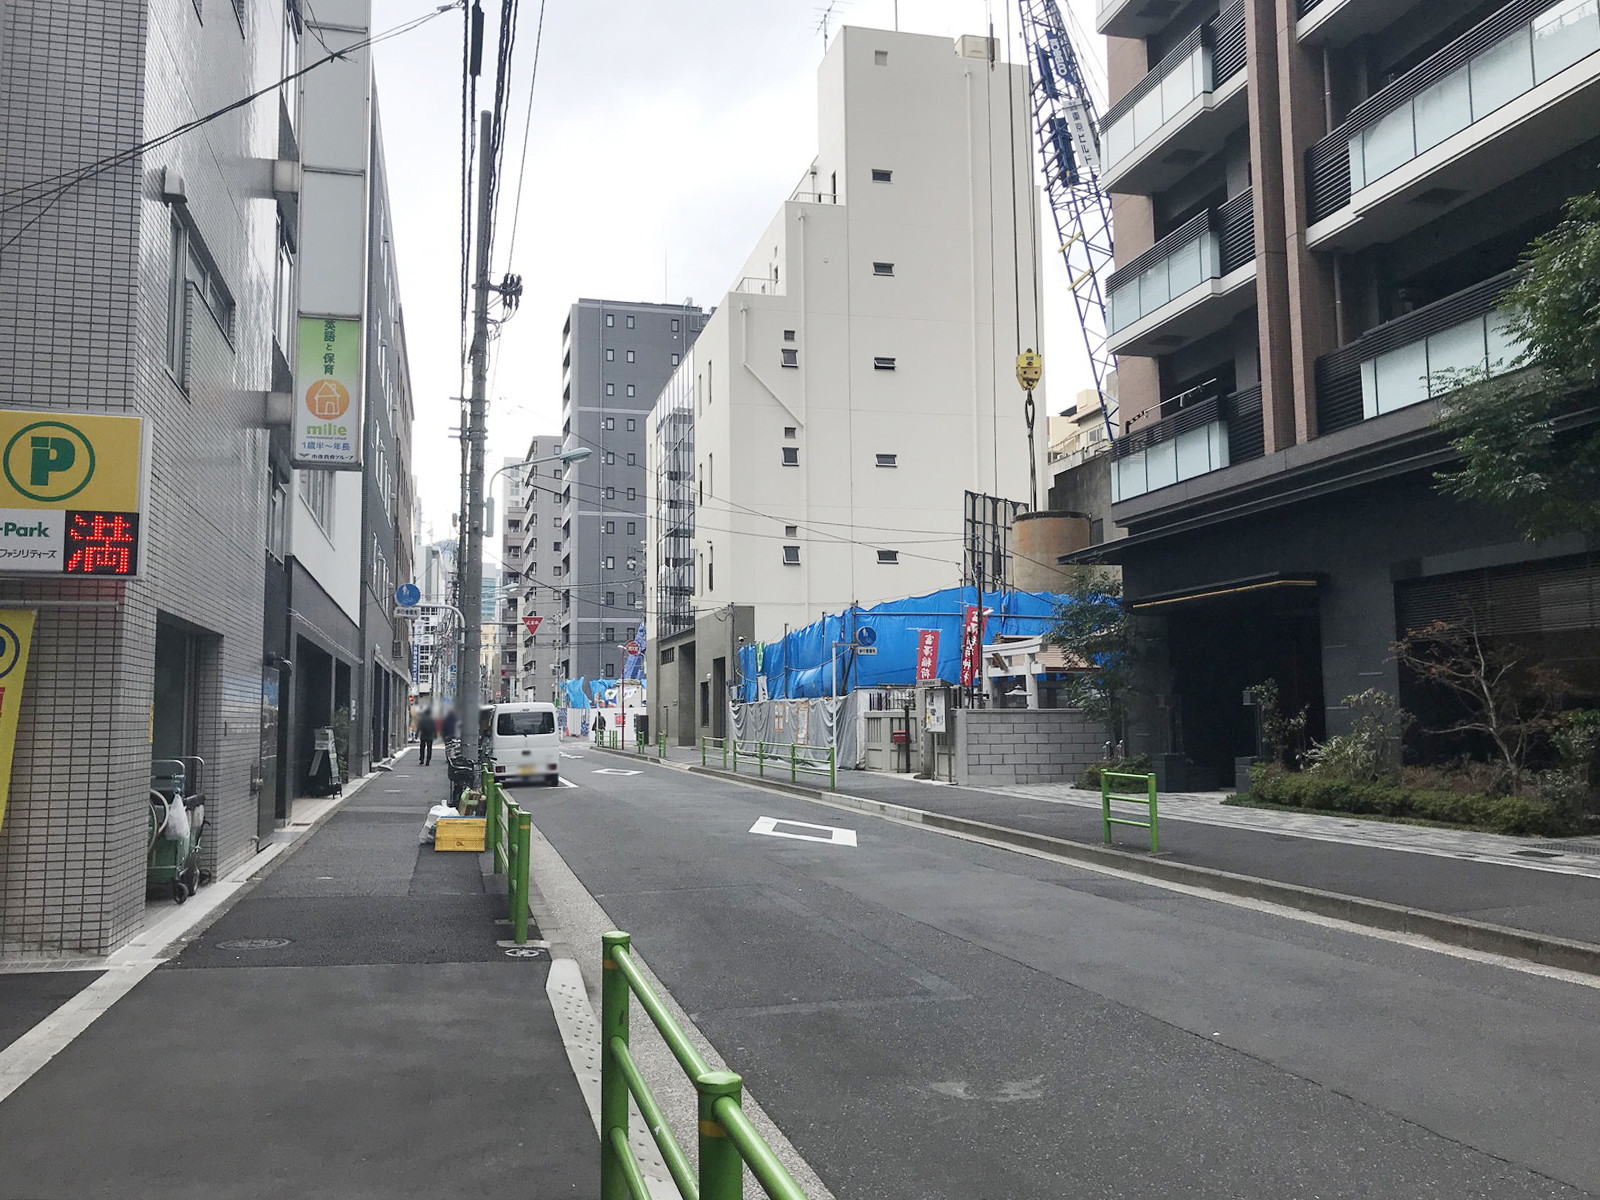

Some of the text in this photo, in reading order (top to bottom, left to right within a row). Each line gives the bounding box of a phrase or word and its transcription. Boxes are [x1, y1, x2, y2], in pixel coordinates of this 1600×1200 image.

[1049, 38, 1067, 76] KOBELCO
[323, 319, 336, 376] 英語と保育
[306, 423, 347, 436] milie
[68, 514, 134, 574] 満
